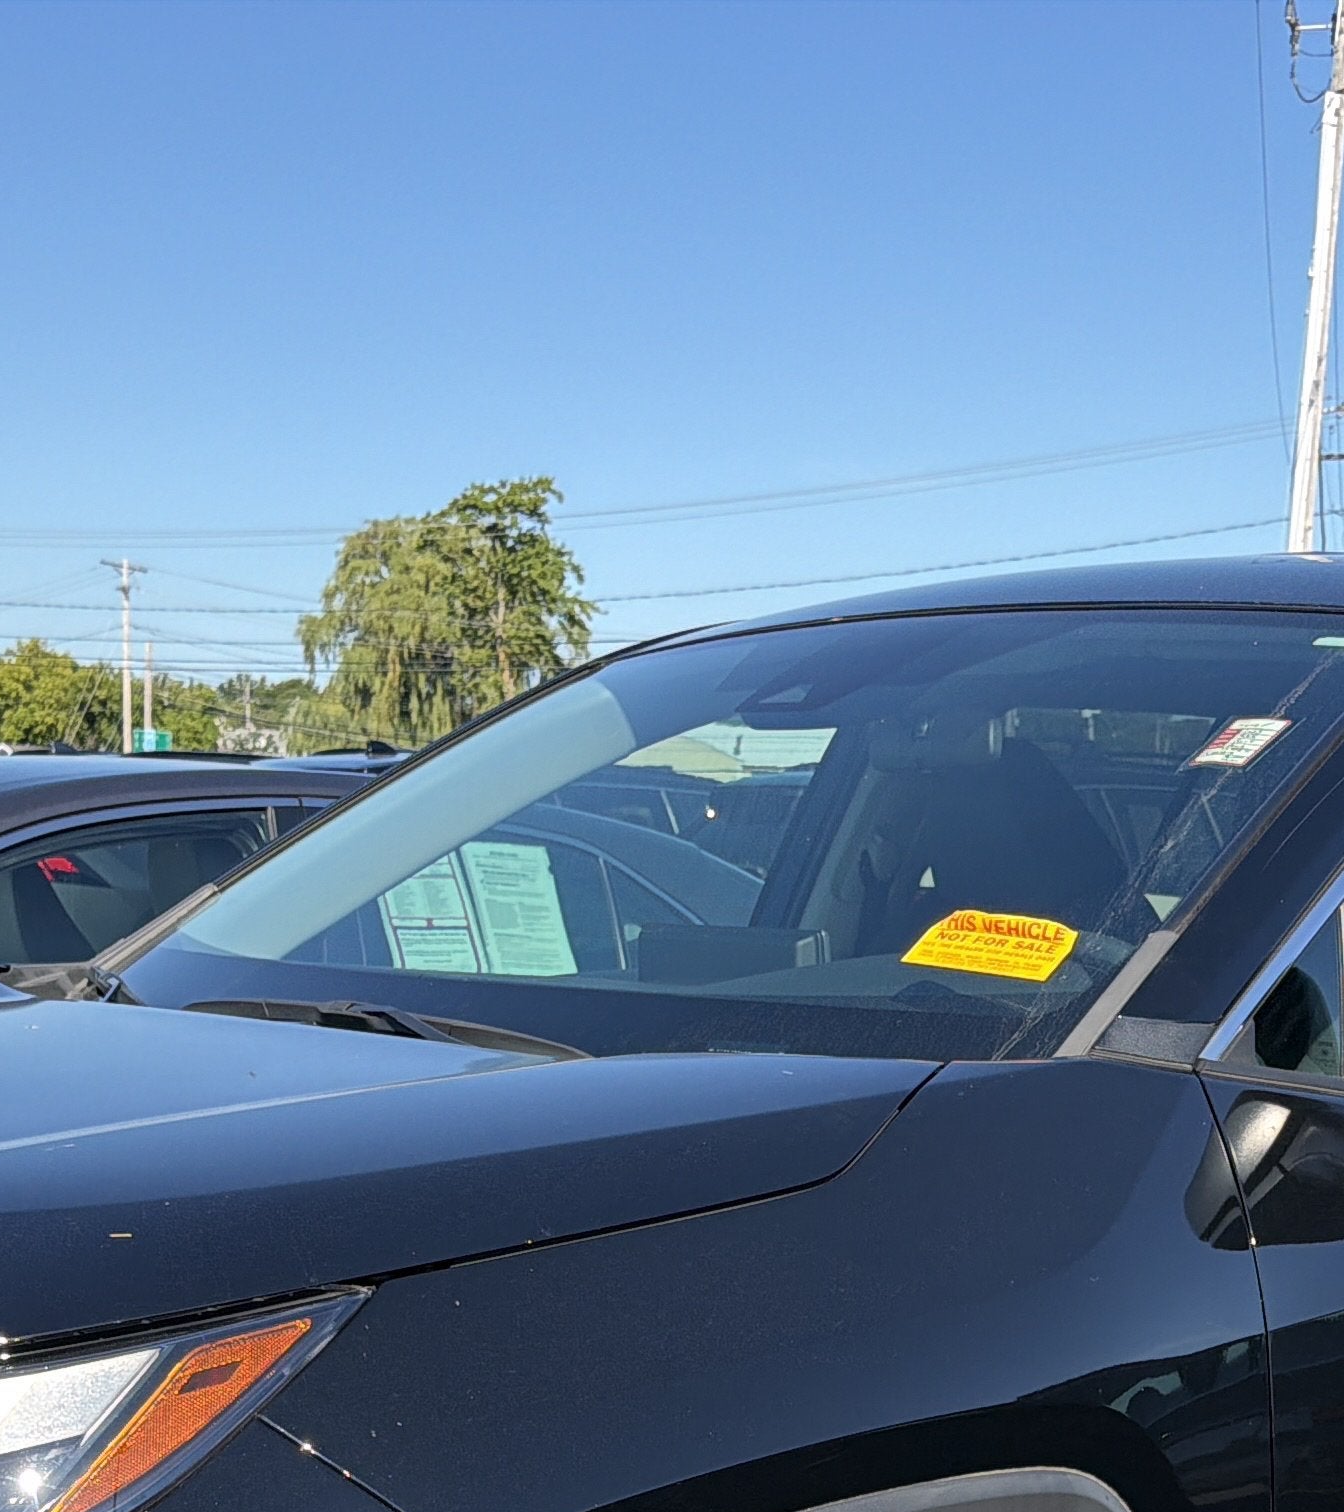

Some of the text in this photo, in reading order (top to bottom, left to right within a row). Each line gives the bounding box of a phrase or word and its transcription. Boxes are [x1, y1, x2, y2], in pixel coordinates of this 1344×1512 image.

[982, 918, 1065, 942] VEHICLE
[935, 931, 971, 942] NOT
[972, 935, 1009, 948] FOR
[1011, 940, 1059, 954] SALE
